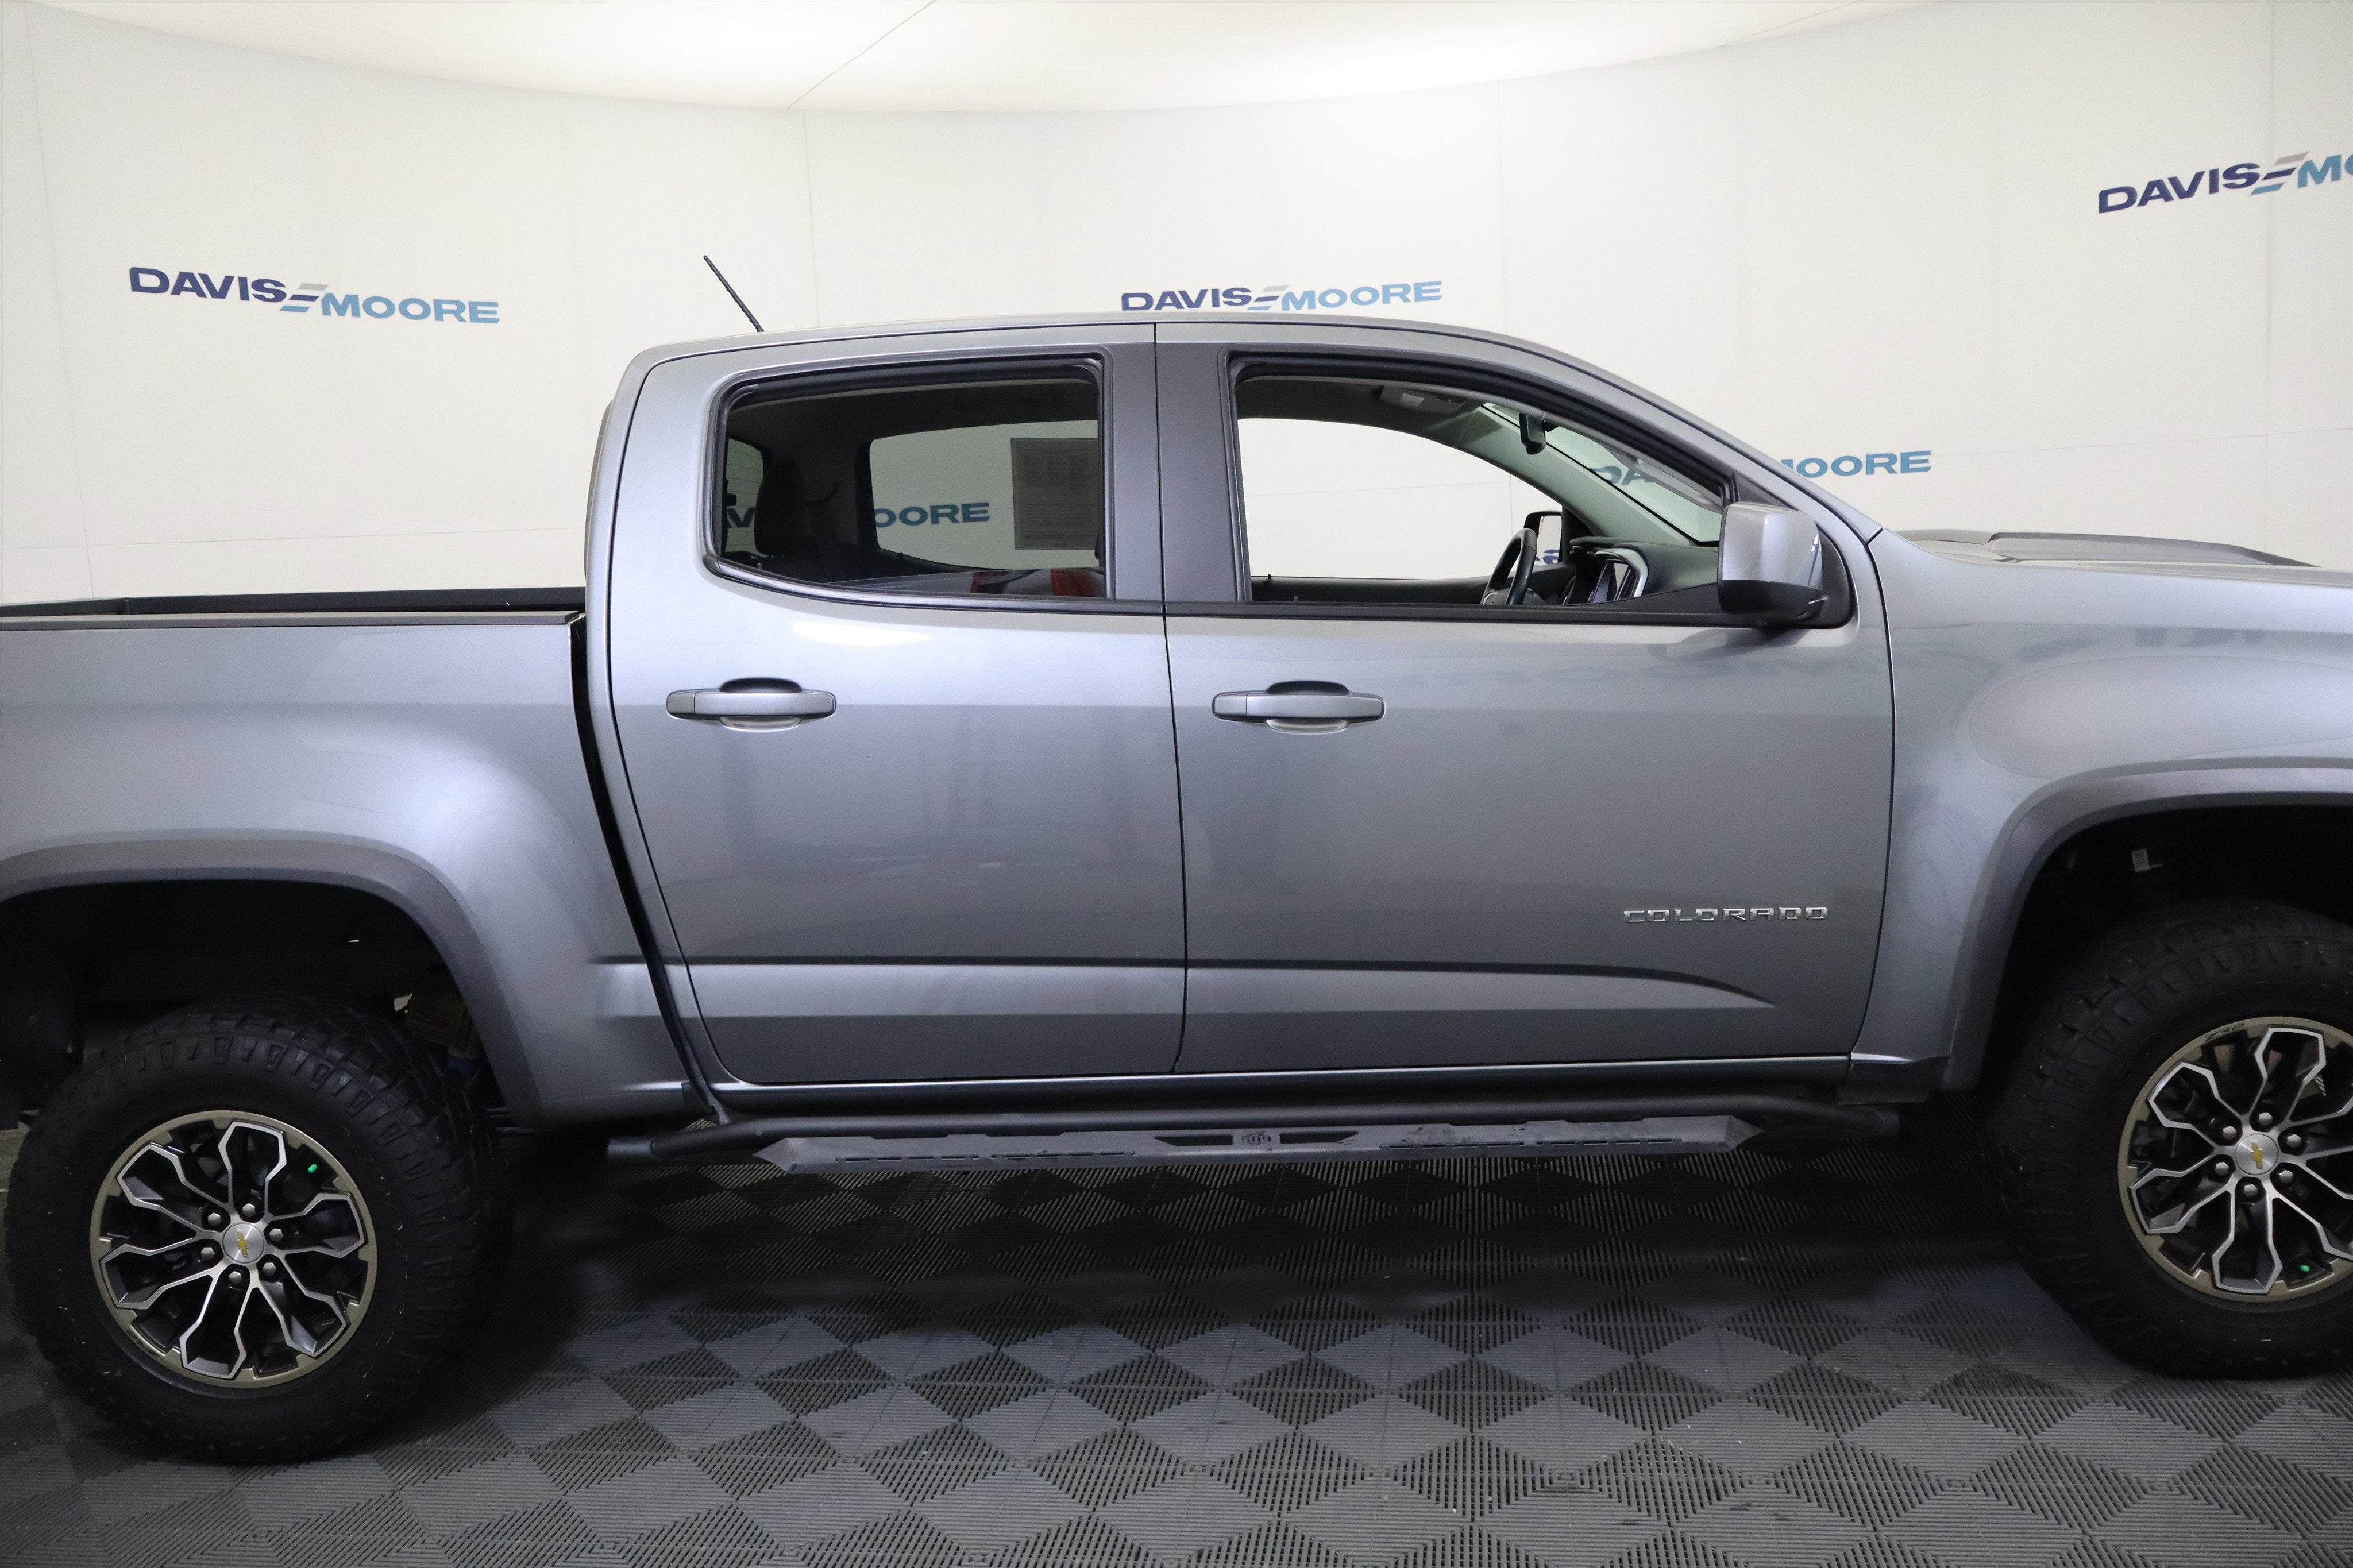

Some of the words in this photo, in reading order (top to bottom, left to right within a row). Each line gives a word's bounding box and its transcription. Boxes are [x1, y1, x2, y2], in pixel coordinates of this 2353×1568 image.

[2099, 162, 2261, 214] DAVIS
[129, 267, 287, 303] DAVIS
[322, 292, 500, 323] MOORE
[1121, 287, 1251, 311] DAVIS
[1281, 280, 1442, 311] MOORE
[874, 502, 990, 527] OORE
[1623, 906, 1828, 922] COLORADO
